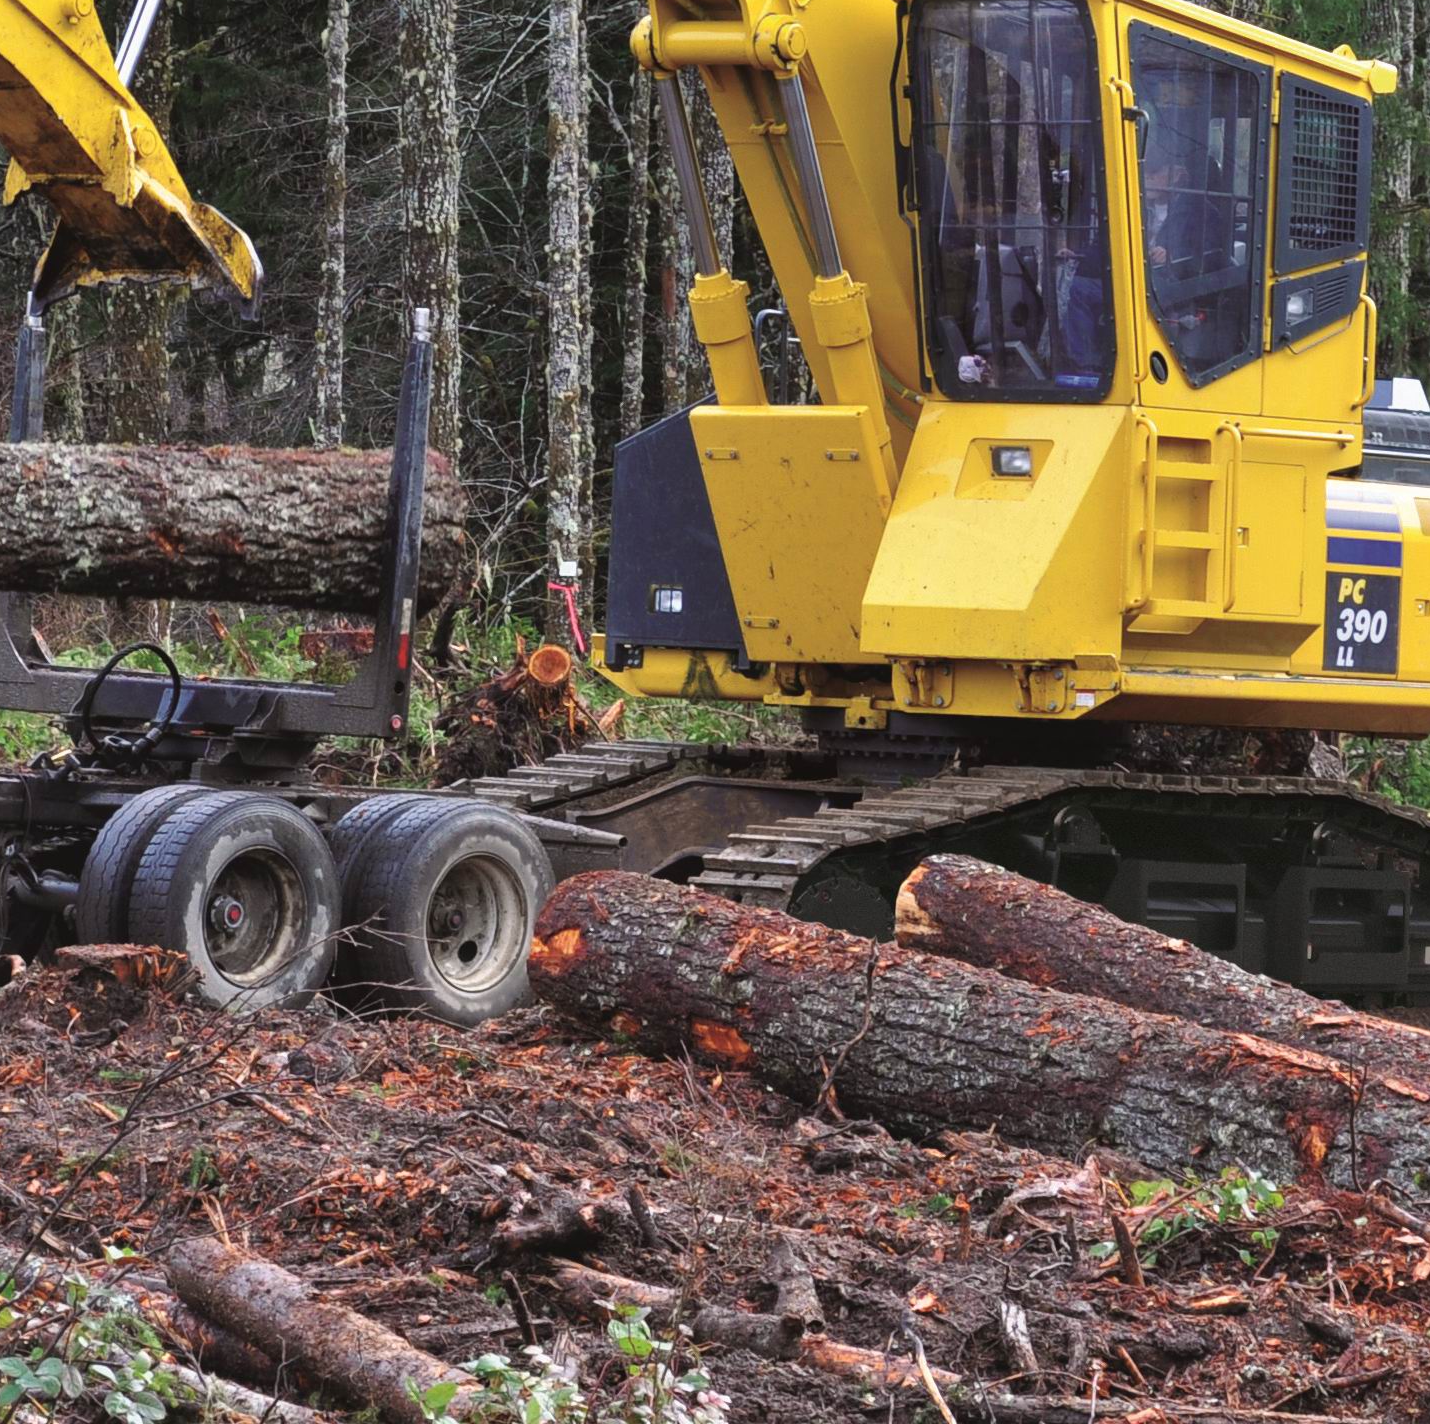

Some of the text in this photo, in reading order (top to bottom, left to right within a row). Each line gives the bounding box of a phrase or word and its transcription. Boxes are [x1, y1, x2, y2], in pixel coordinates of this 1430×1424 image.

[1338, 577, 1367, 604] PC
[1336, 607, 1388, 644] 390
[1336, 645, 1354, 667] LL
